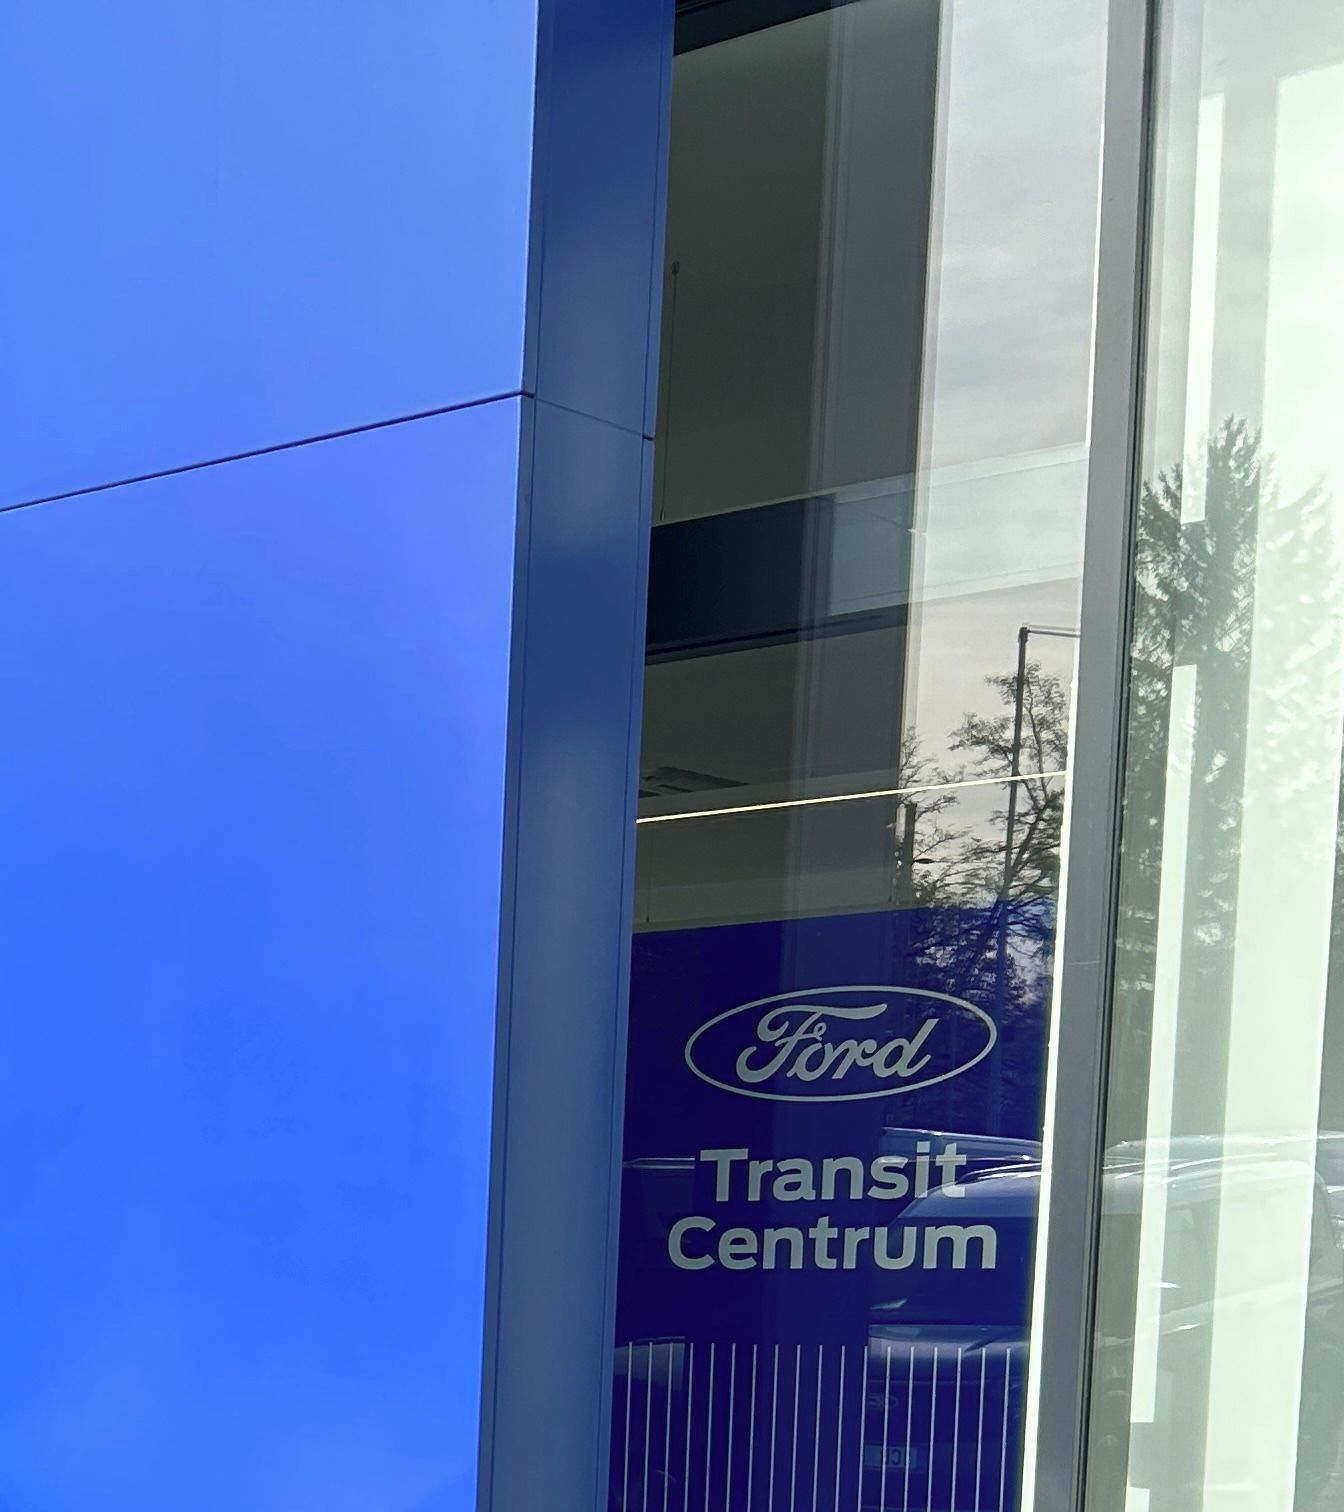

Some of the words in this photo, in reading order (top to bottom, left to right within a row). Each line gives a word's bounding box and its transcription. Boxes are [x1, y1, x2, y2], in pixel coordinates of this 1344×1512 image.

[735, 1003, 940, 1084] Ford
[700, 1141, 968, 1202] Transit
[667, 1216, 998, 1270] Centrum
